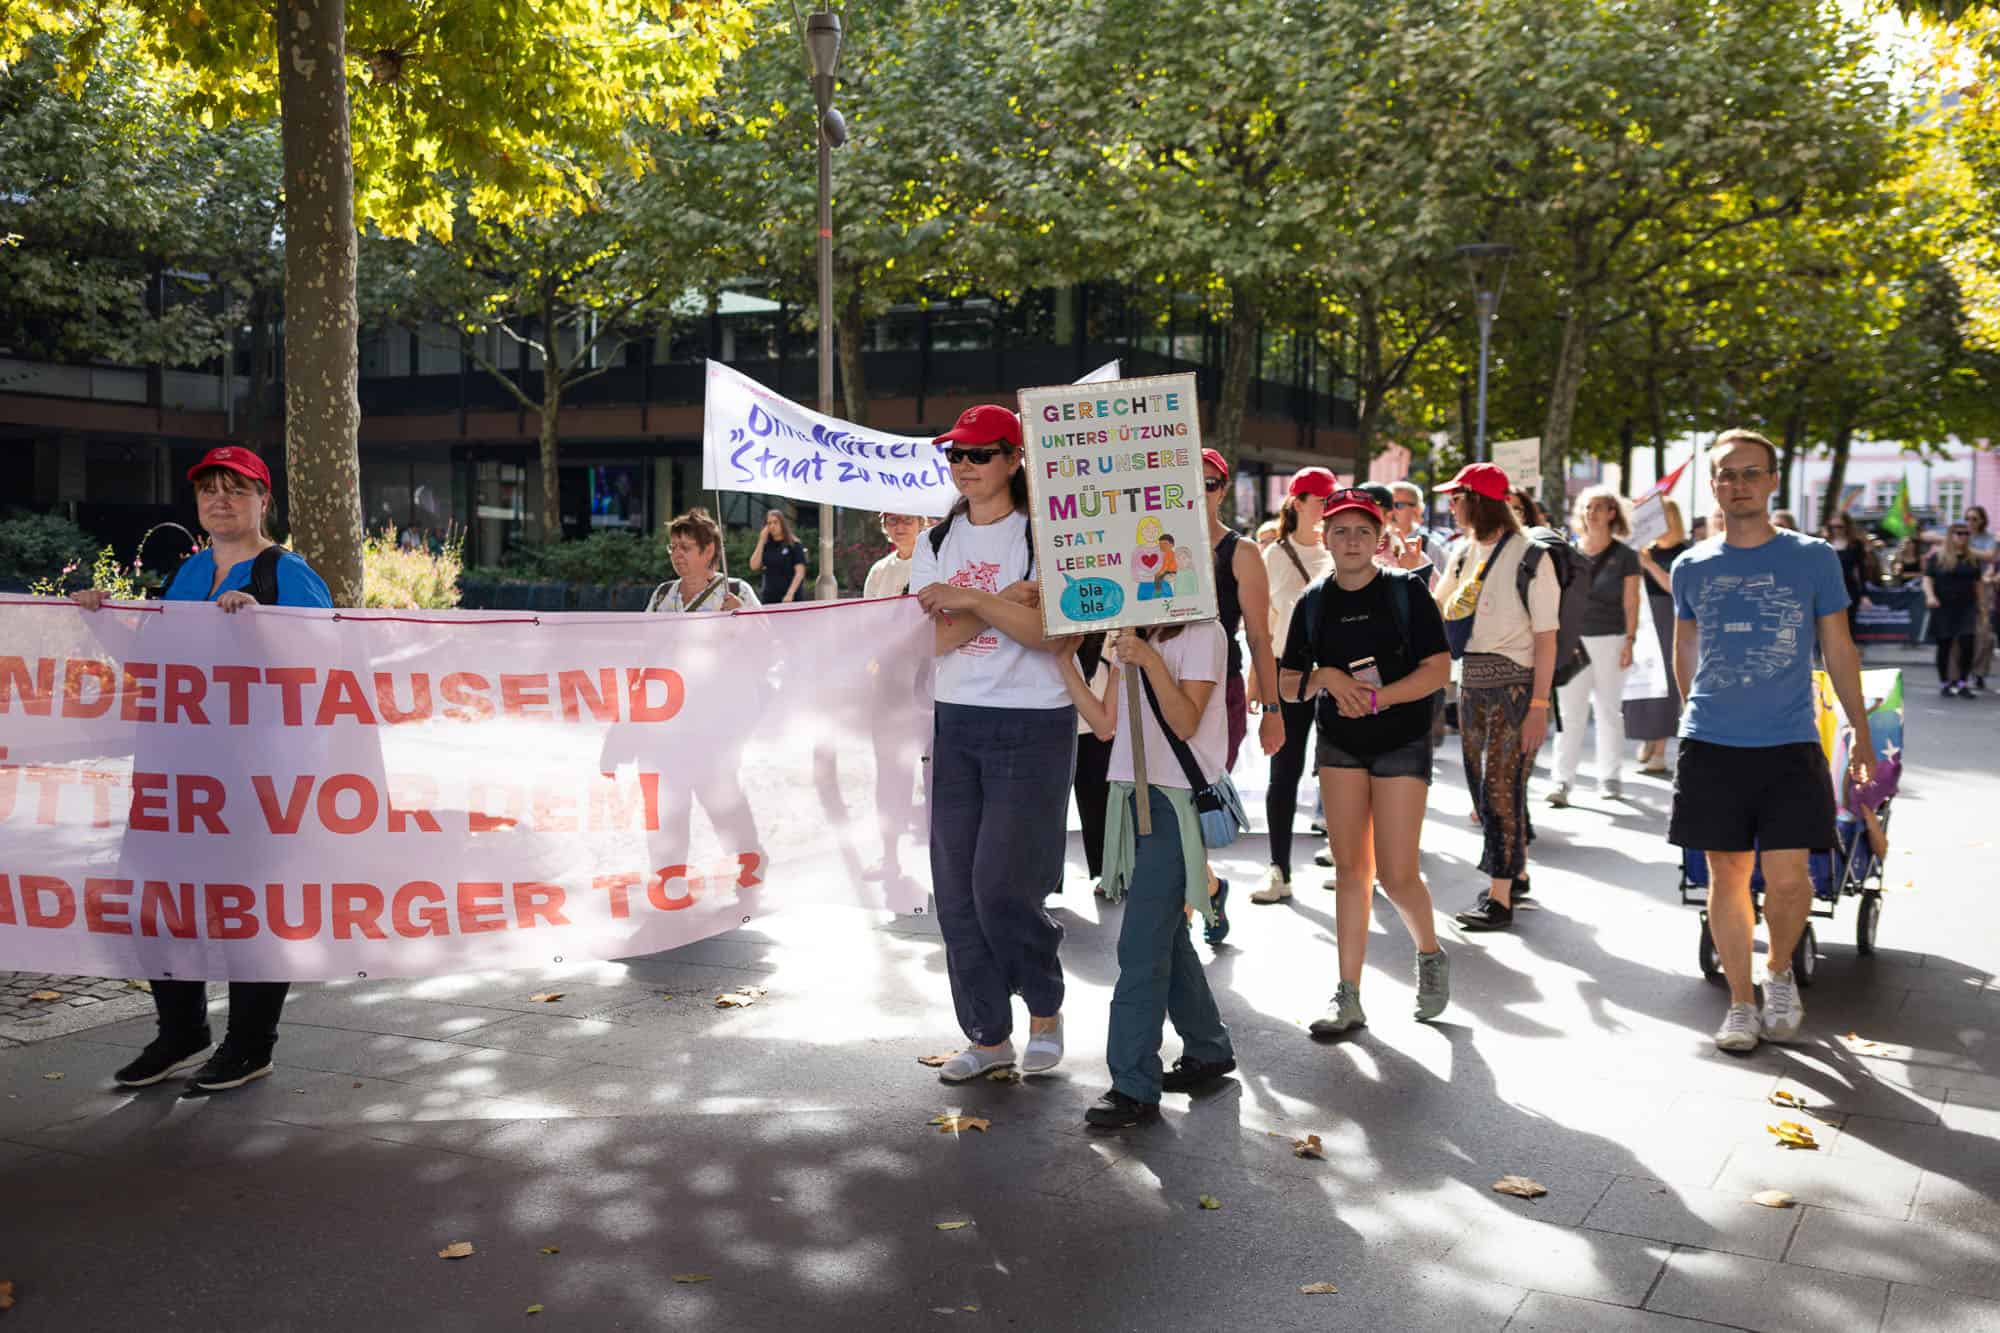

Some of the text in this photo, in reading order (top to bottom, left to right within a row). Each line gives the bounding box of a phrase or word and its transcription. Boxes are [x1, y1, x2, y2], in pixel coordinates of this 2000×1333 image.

[1043, 393, 1180, 422] GERECHTE
[1041, 422, 1188, 449] UNTERSTÜTZUNG
[730, 440, 828, 484] Staat
[1046, 448, 1190, 479] FÜR UNSERE
[1049, 484, 1194, 521] MÜTTER,
[1053, 530, 1105, 548] STATT
[1056, 552, 1122, 573] LEEREM
[1079, 584, 1103, 598] bla
[1081, 600, 1105, 614] bla
[252, 773, 442, 835] VOR
